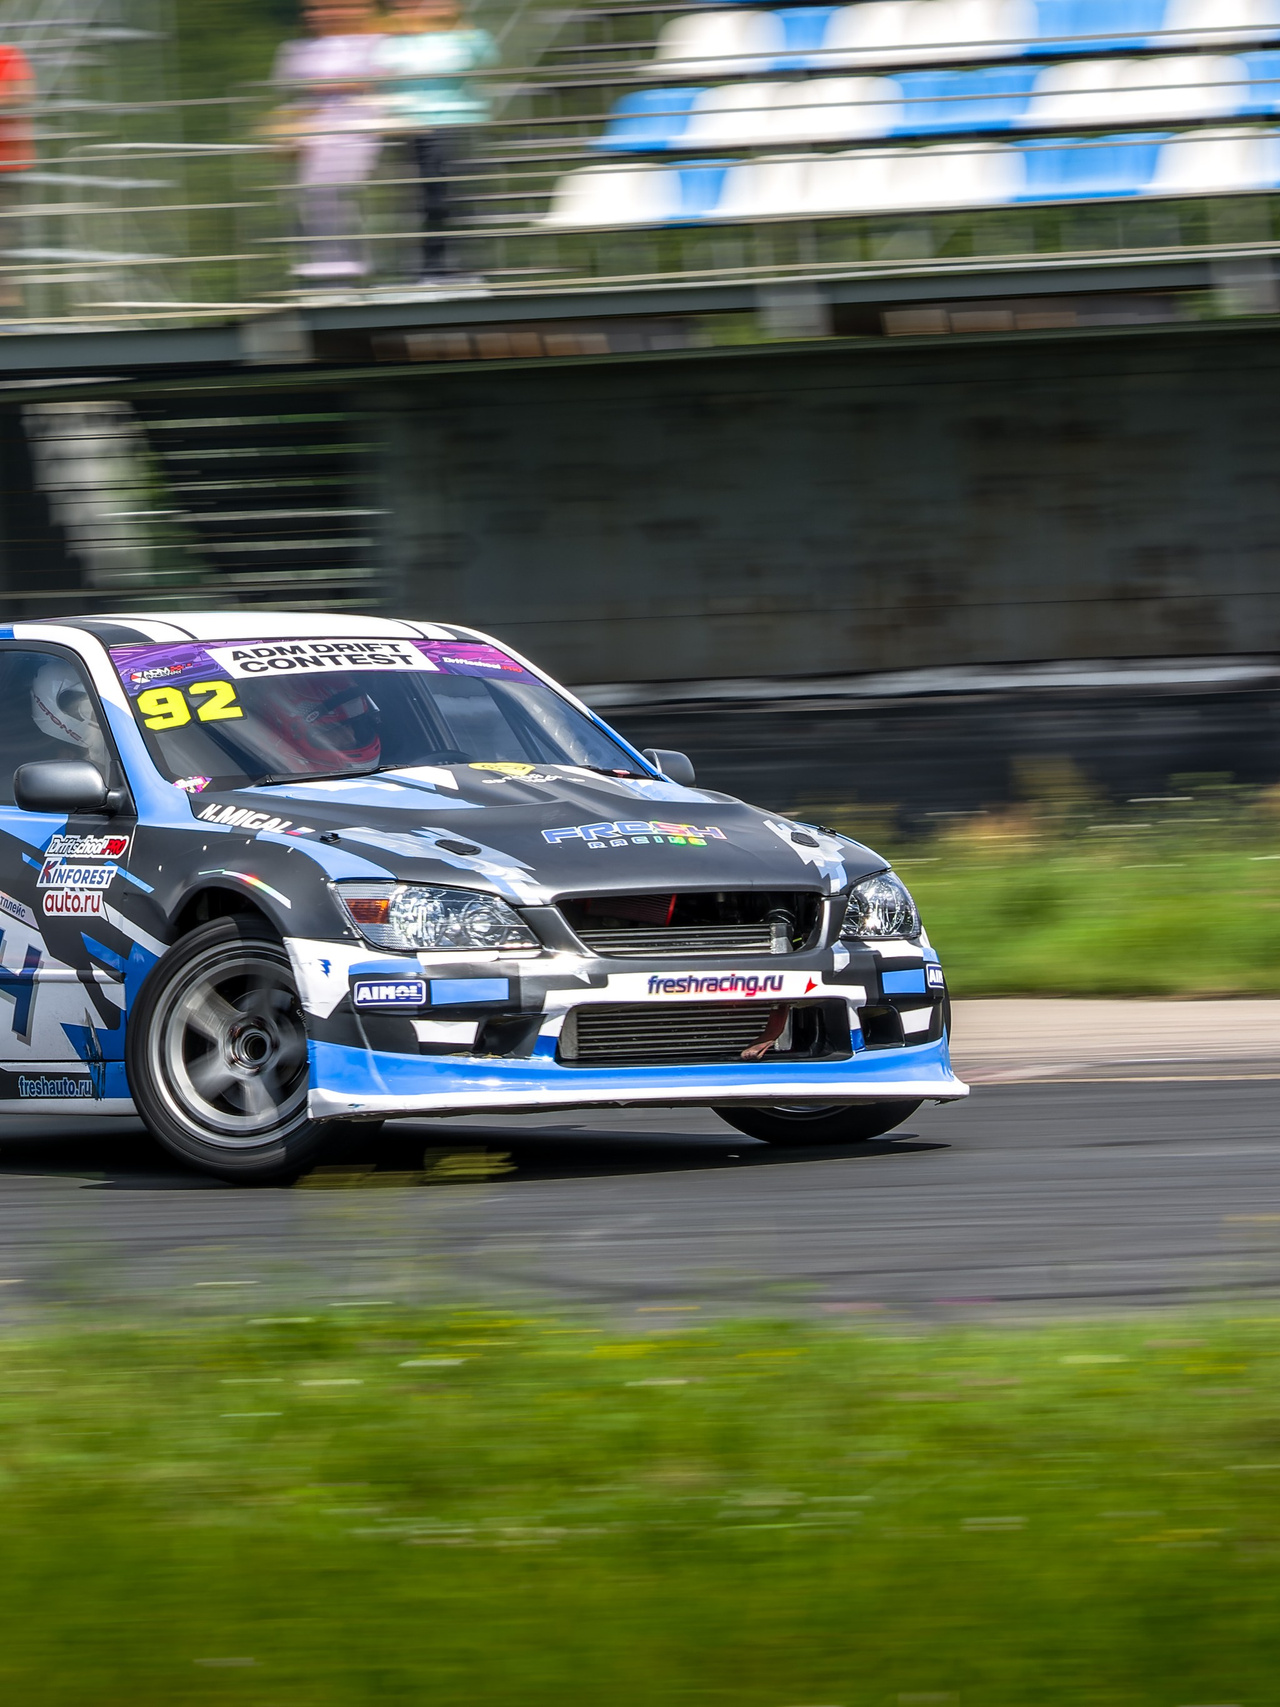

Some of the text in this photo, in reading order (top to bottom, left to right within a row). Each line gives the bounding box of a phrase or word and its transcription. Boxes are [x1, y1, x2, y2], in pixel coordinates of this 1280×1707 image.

[232, 643, 401, 661] ADM DRIFT
[239, 654, 414, 673] CONTEST
[137, 680, 243, 731] 92
[588, 836, 708, 849] RACING
[39, 861, 114, 885] KINFOREST
[44, 892, 100, 913] auto.ru
[647, 974, 784, 997] freshracing.ru
[19, 1076, 92, 1096] freshauto.ru
